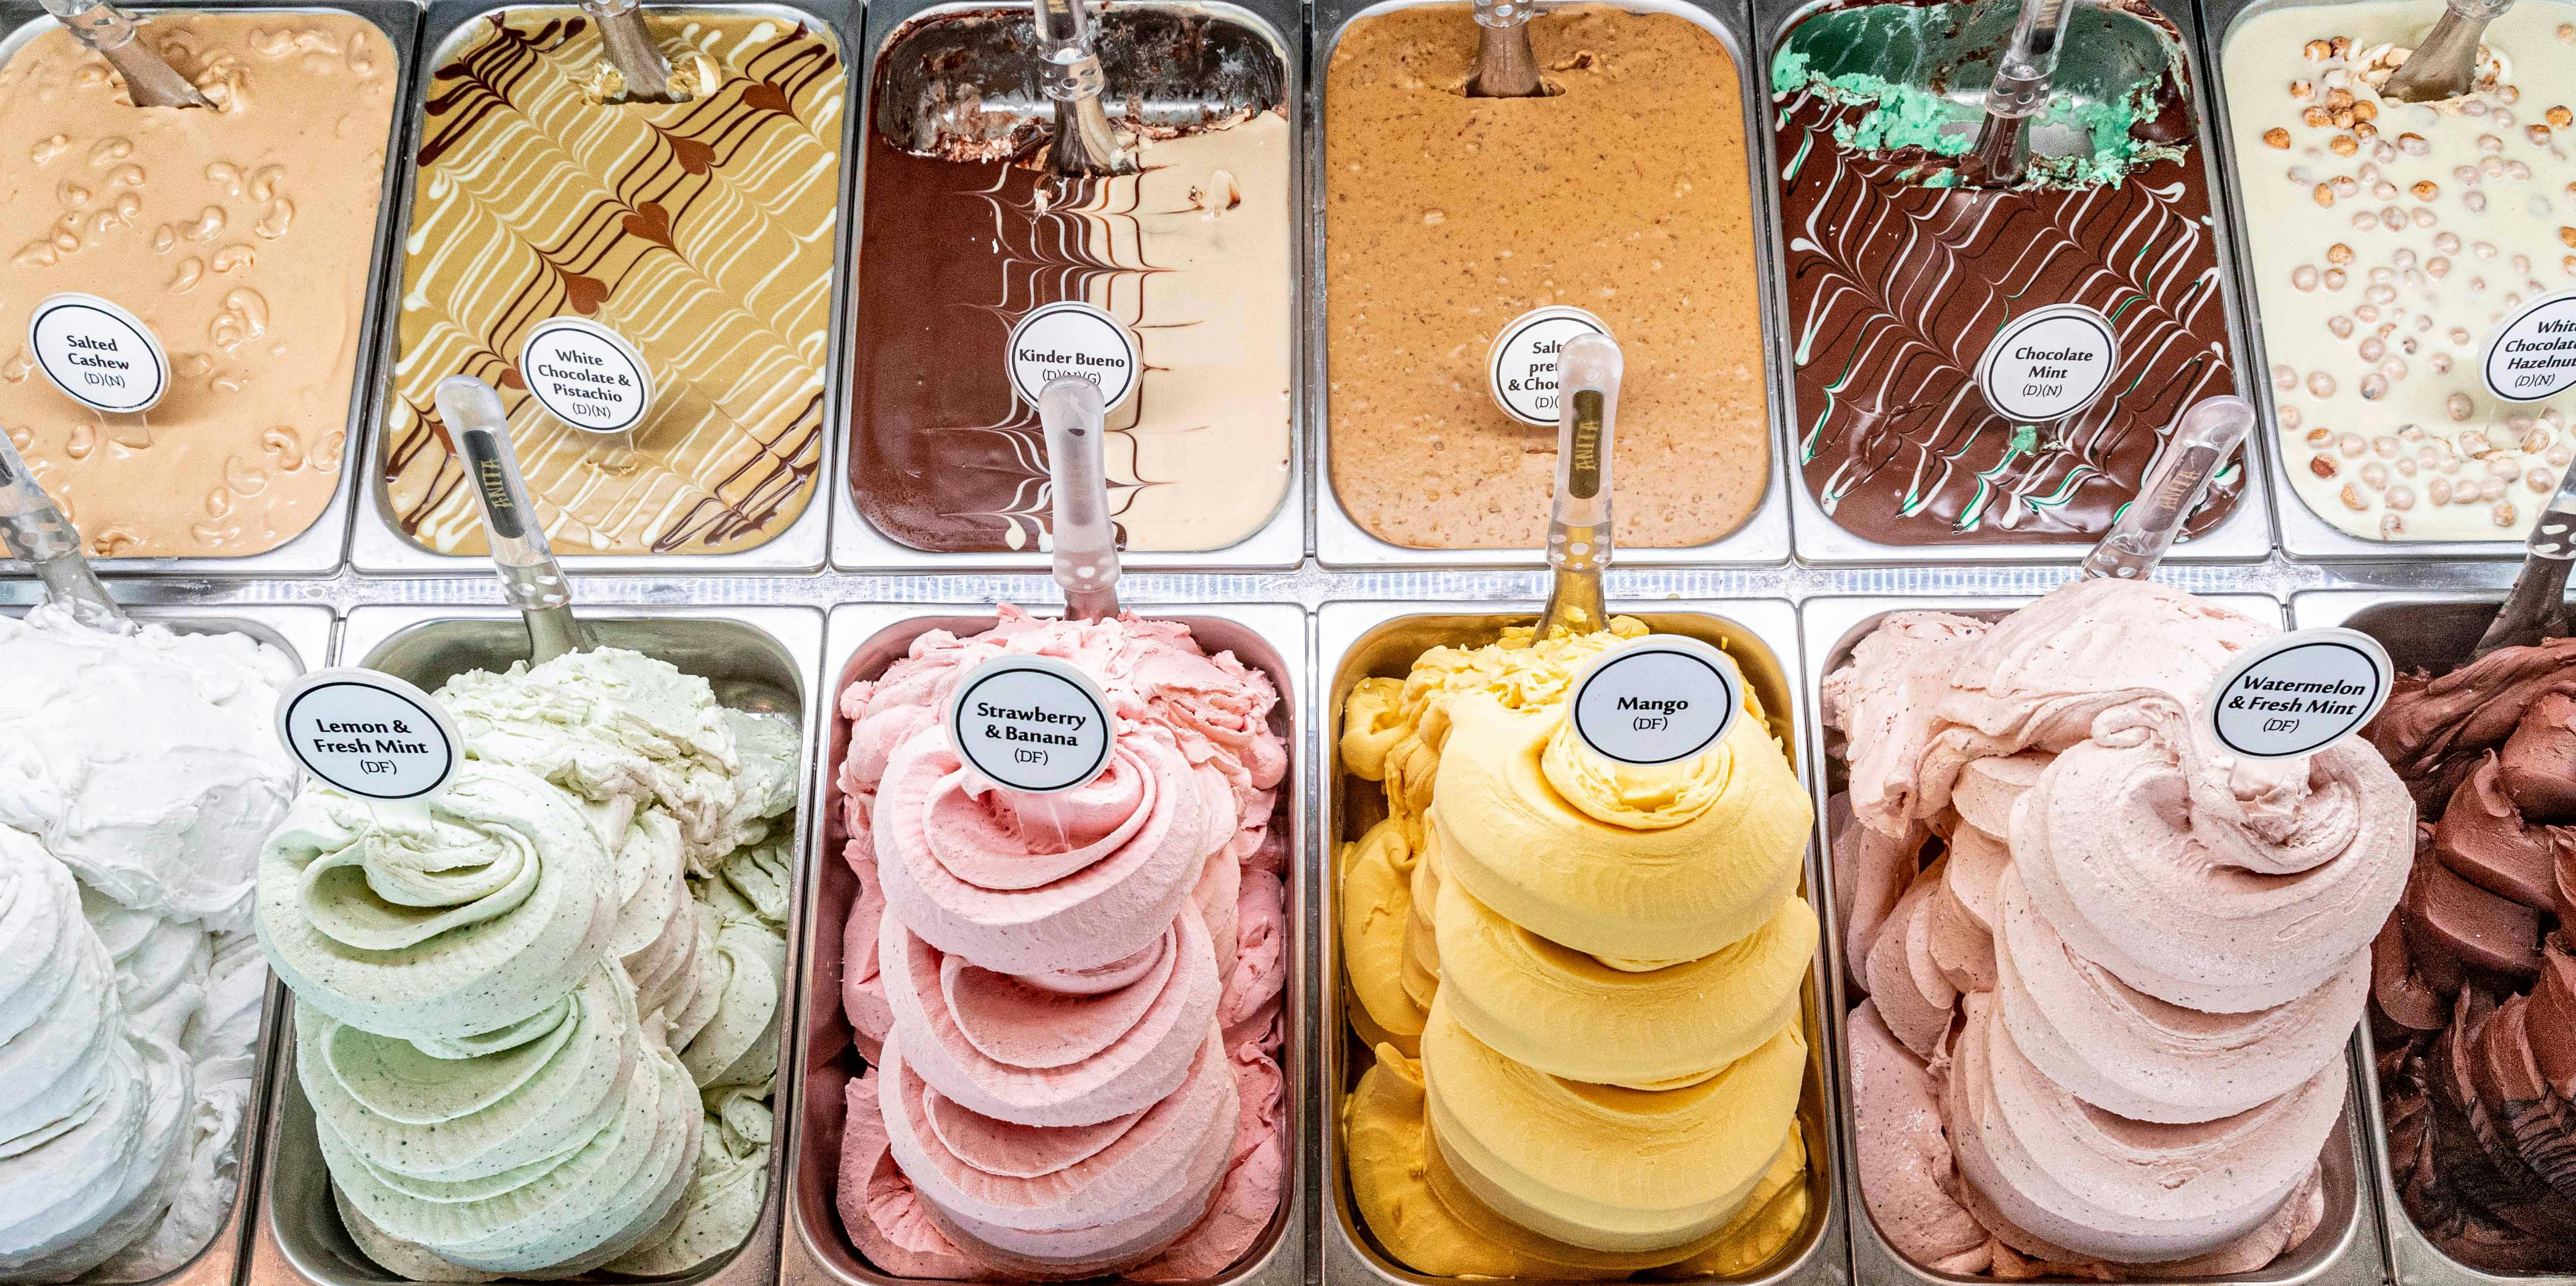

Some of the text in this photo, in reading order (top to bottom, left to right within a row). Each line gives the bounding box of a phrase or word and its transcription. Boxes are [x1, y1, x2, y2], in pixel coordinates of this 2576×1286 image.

[2538, 319, 2576, 333] Whit
[67, 335, 118, 351] Salted
[1532, 340, 1563, 354] Salt
[68, 353, 129, 370] Cashew
[555, 349, 604, 366] White
[1019, 349, 1125, 368] Kinder Bueno
[2015, 346, 2093, 361] Chocolate
[84, 372, 125, 388] (D)(N)
[538, 364, 632, 387] Chocolate &
[2028, 366, 2068, 378] Mint
[1508, 379, 1521, 391] &
[2515, 373, 2555, 388] (D)(N)
[553, 383, 622, 402] Pistachio
[2023, 383, 2062, 398] (D)(N)
[1535, 395, 1559, 409] (D)(
[573, 402, 611, 419] (D)(N)
[1576, 421, 1598, 471] ANITA
[480, 458, 515, 508] ANITA
[2244, 676, 2366, 696] Watermelon
[1617, 696, 1688, 715] Mango
[2228, 695, 2358, 715] & Fresh Mint
[978, 702, 1086, 731] Strawberry
[1633, 717, 1668, 731] (DF)
[316, 719, 412, 733] Lemon &
[2263, 718, 2300, 734] (DF)
[985, 724, 1078, 747] & Banana
[313, 738, 429, 754] Fresh Mint
[1015, 748, 1049, 766] (DF)
[360, 759, 397, 775] (DF)
